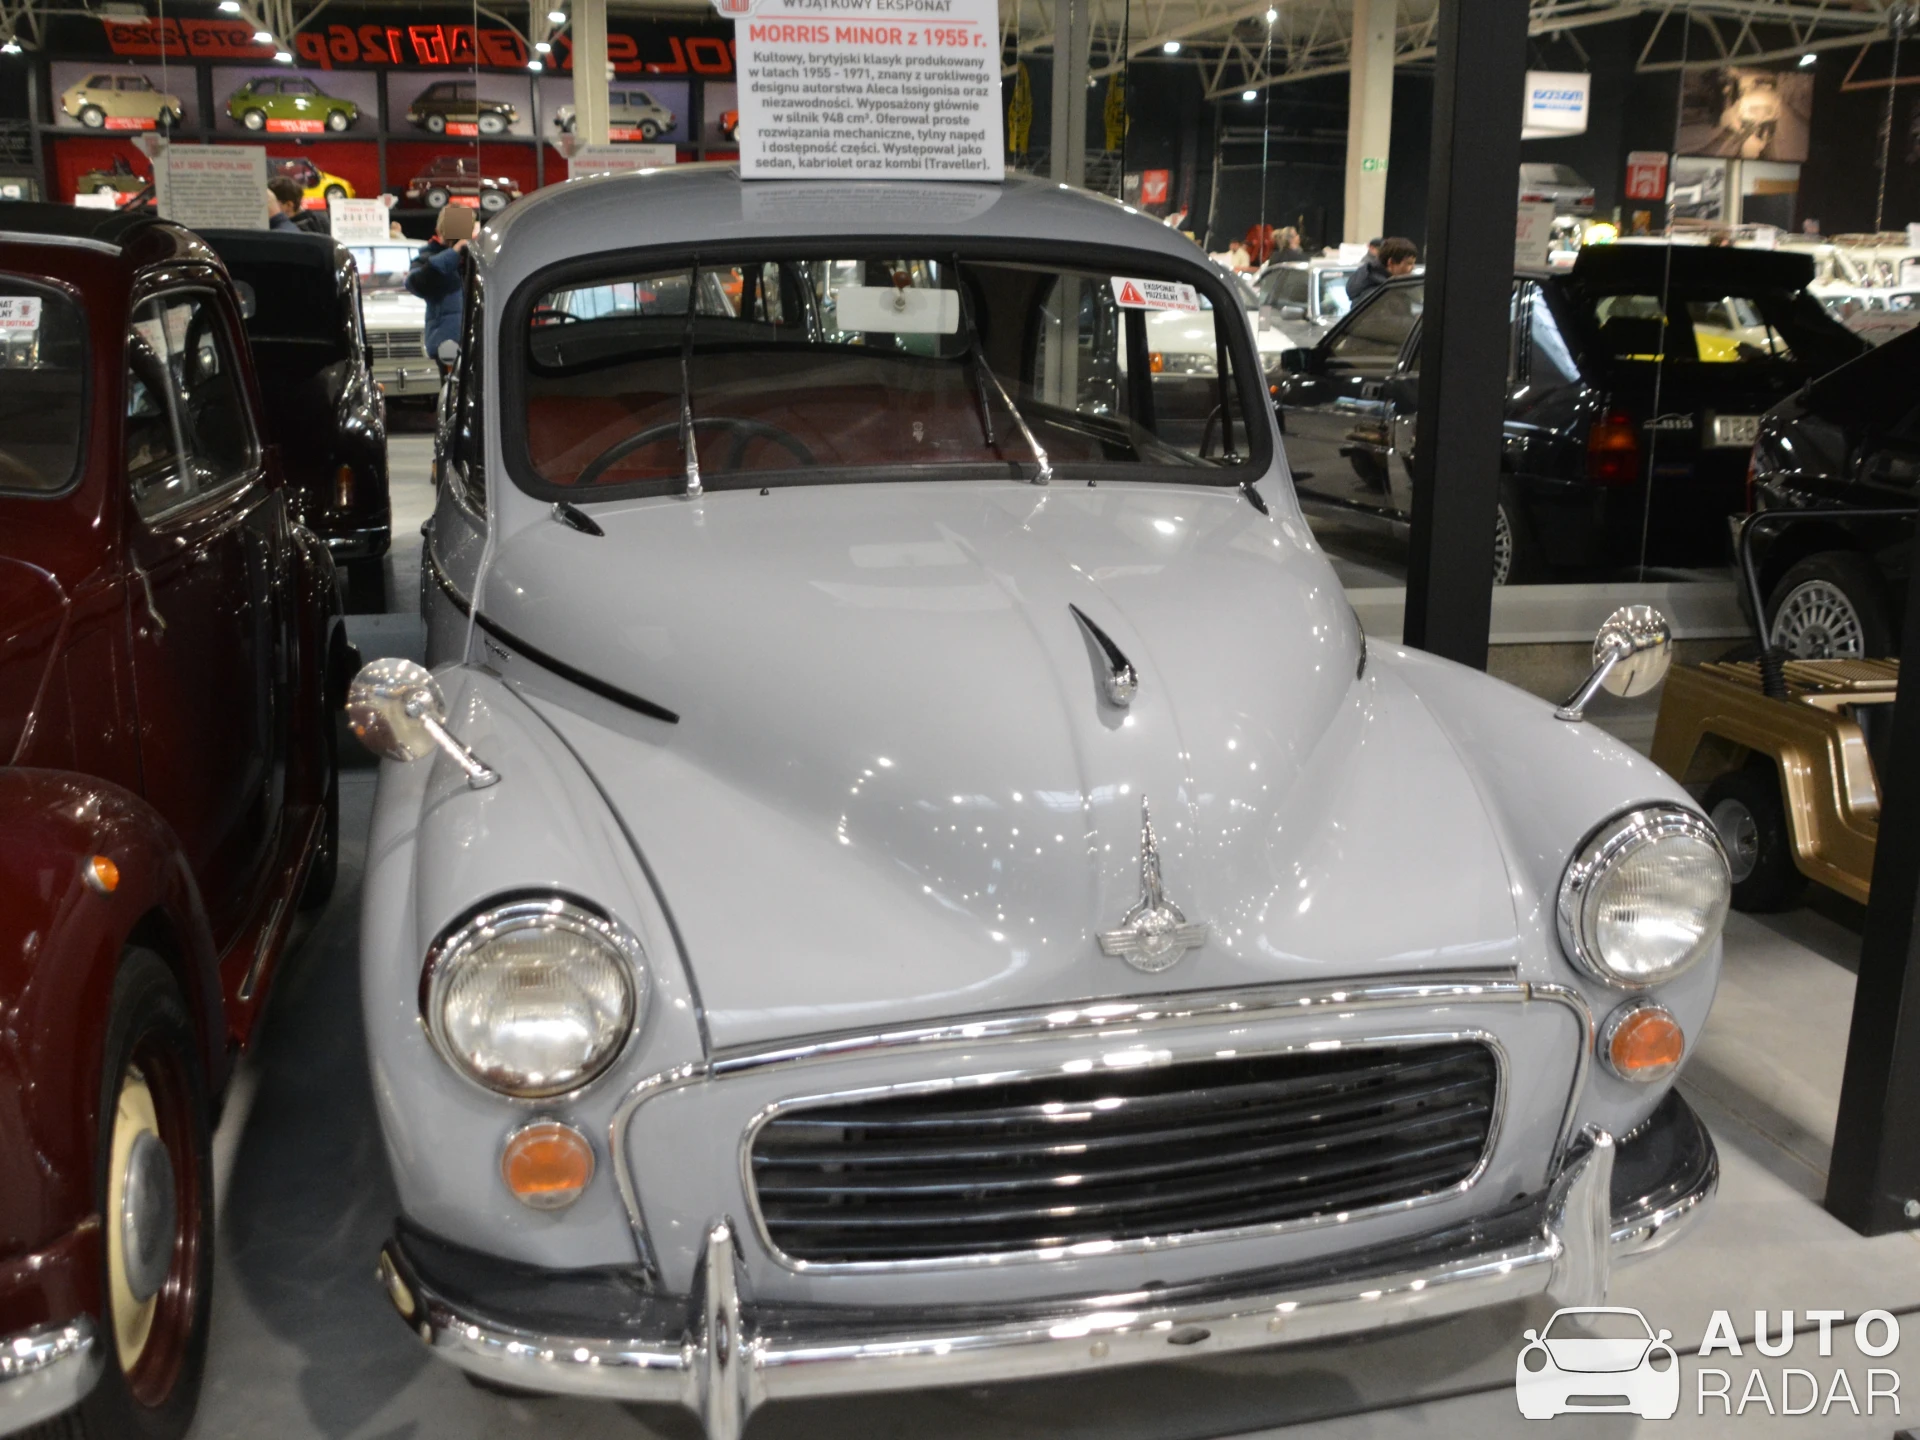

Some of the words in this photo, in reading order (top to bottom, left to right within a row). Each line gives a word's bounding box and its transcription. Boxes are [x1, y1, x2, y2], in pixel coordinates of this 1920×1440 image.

[877, 0, 952, 11] EKSPONAT
[749, 24, 830, 43] MORRIS
[835, 26, 902, 45] MINOR
[908, 31, 918, 45] z
[924, 28, 969, 47] 1955
[973, 33, 987, 48] r.
[753, 51, 806, 65] Kultowy,
[809, 52, 861, 66] brytyjski
[864, 53, 903, 67] klasyk
[905, 55, 985, 69] produkowany
[748, 68, 759, 78] w
[762, 66, 799, 78] latach
[803, 67, 832, 78] 1955
[843, 68, 875, 81] 1971,
[877, 70, 912, 82] znany
[915, 71, 922, 80] z
[924, 70, 990, 84] urokliwego
[751, 82, 799, 95] designu
[802, 83, 863, 94] autorstwa
[866, 84, 898, 95] Aleca
[902, 84, 960, 98] Issigonisa
[963, 88, 989, 97] oraz
[762, 97, 854, 109] niezawodności.
[857, 97, 931, 112] Wyposażony
[934, 99, 980, 113] głównie
[772, 113, 783, 123] w
[786, 111, 819, 123] silnik
[822, 112, 844, 123] 948
[876, 113, 929, 125] Oferował
[932, 115, 971, 127] proste
[758, 127, 830, 140] rozwiązania
[833, 128, 915, 141] mechaniczne,
[918, 128, 947, 142] tylny
[949, 129, 986, 144] napęd
[762, 142, 767, 153] i
[769, 141, 838, 156] dostępność
[840, 142, 881, 156] części.
[883, 142, 956, 157] Występował
[957, 144, 983, 157] jako
[755, 158, 796, 170] sedan,
[798, 158, 853, 169] kabriolet
[855, 159, 882, 169] oraz
[885, 158, 922, 169] kombi
[924, 158, 991, 171] (Traveller).
[1145, 291, 1178, 301] MUZEALNY
